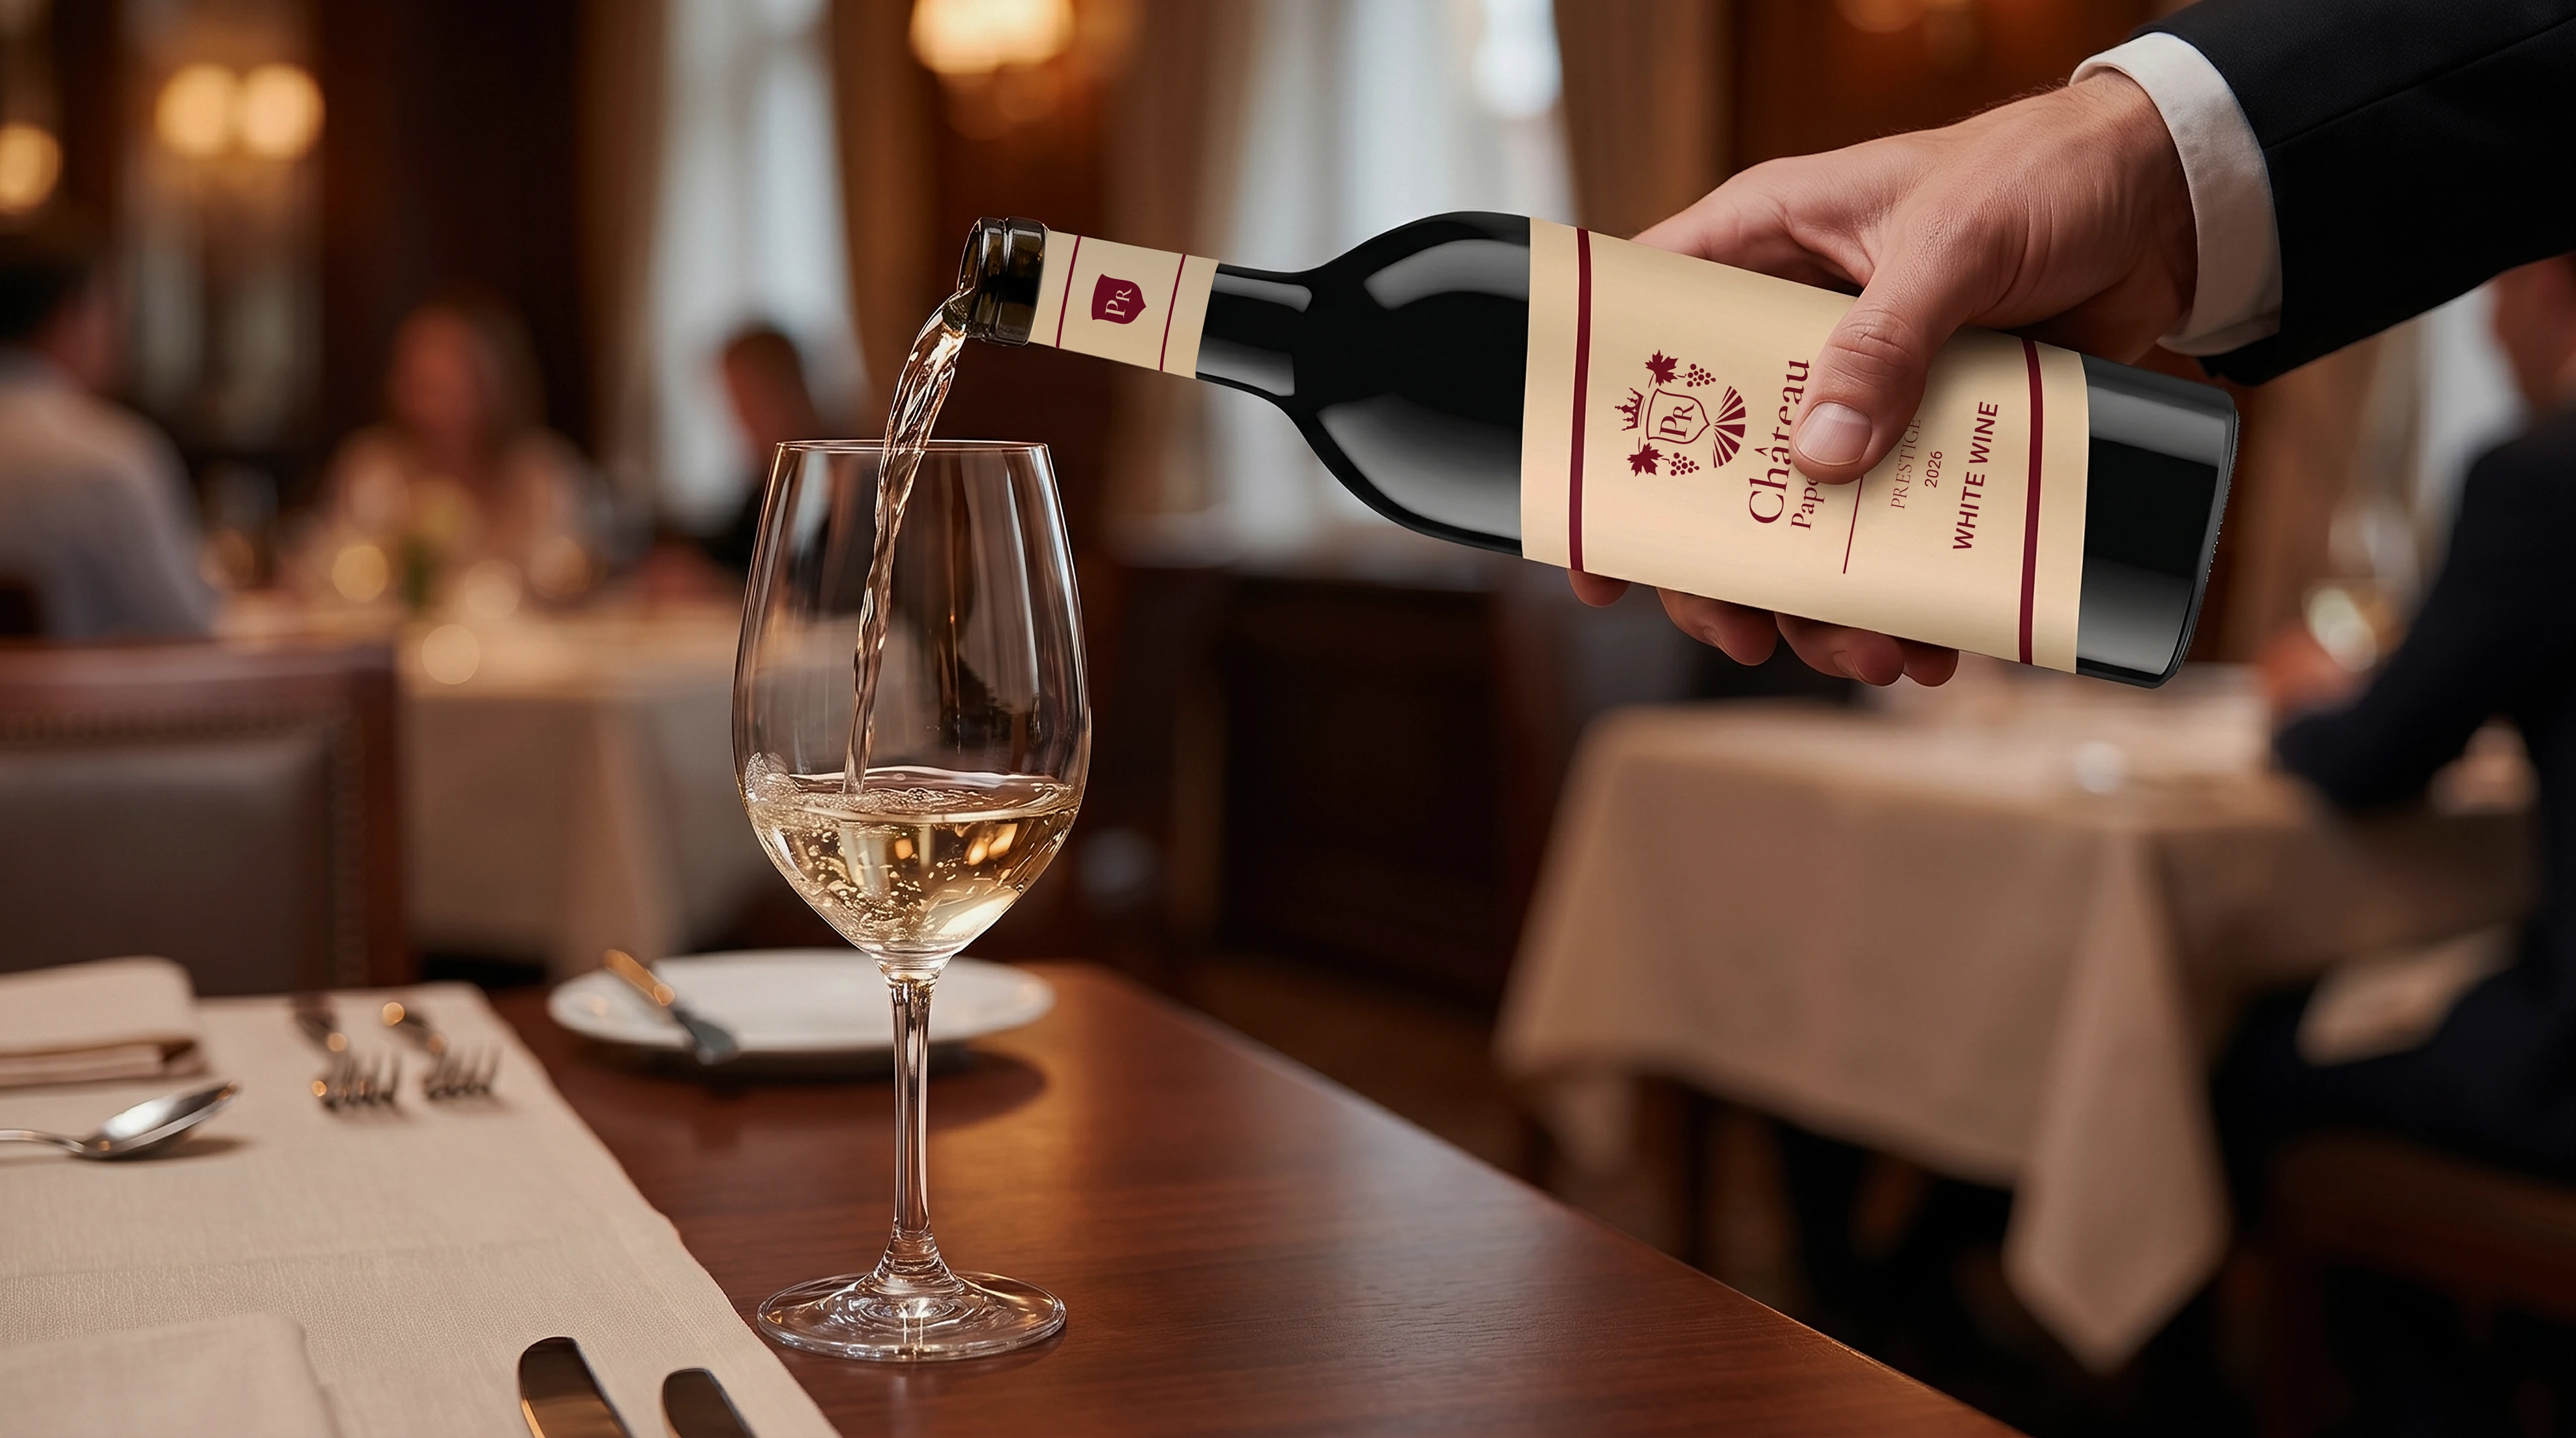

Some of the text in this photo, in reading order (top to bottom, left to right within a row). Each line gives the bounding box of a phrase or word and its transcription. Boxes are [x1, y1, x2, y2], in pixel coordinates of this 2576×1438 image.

[1104, 287, 1132, 319] PR
[1658, 403, 1695, 440] PR
[1748, 359, 1810, 524] Château
[1890, 419, 1921, 510] PRESTIGE
[1924, 450, 1943, 489] 2026
[1952, 401, 1999, 550] WHITE WINE
